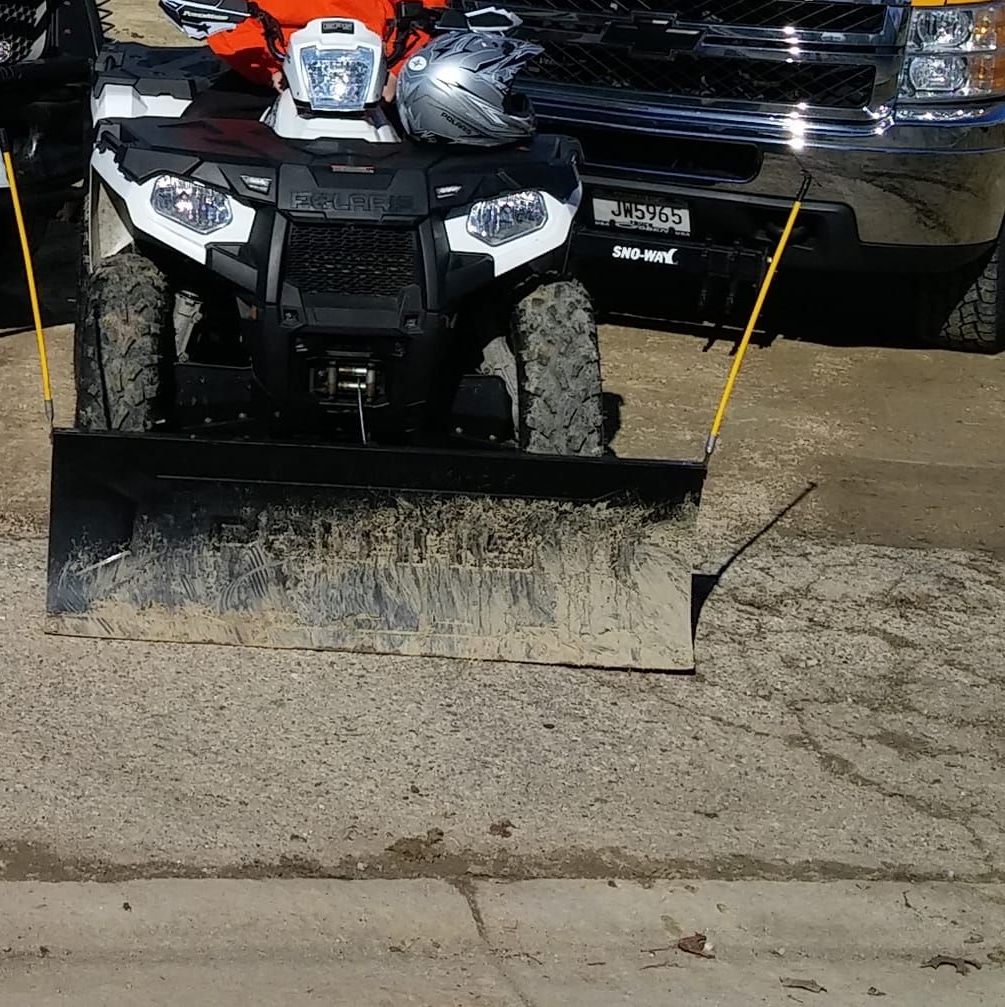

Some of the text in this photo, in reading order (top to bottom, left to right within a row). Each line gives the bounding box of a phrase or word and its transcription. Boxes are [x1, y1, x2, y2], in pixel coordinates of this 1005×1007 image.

[291, 192, 415, 211] POLARIS
[611, 201, 682, 224] JW5965
[612, 245, 678, 265] SNO-WAY
